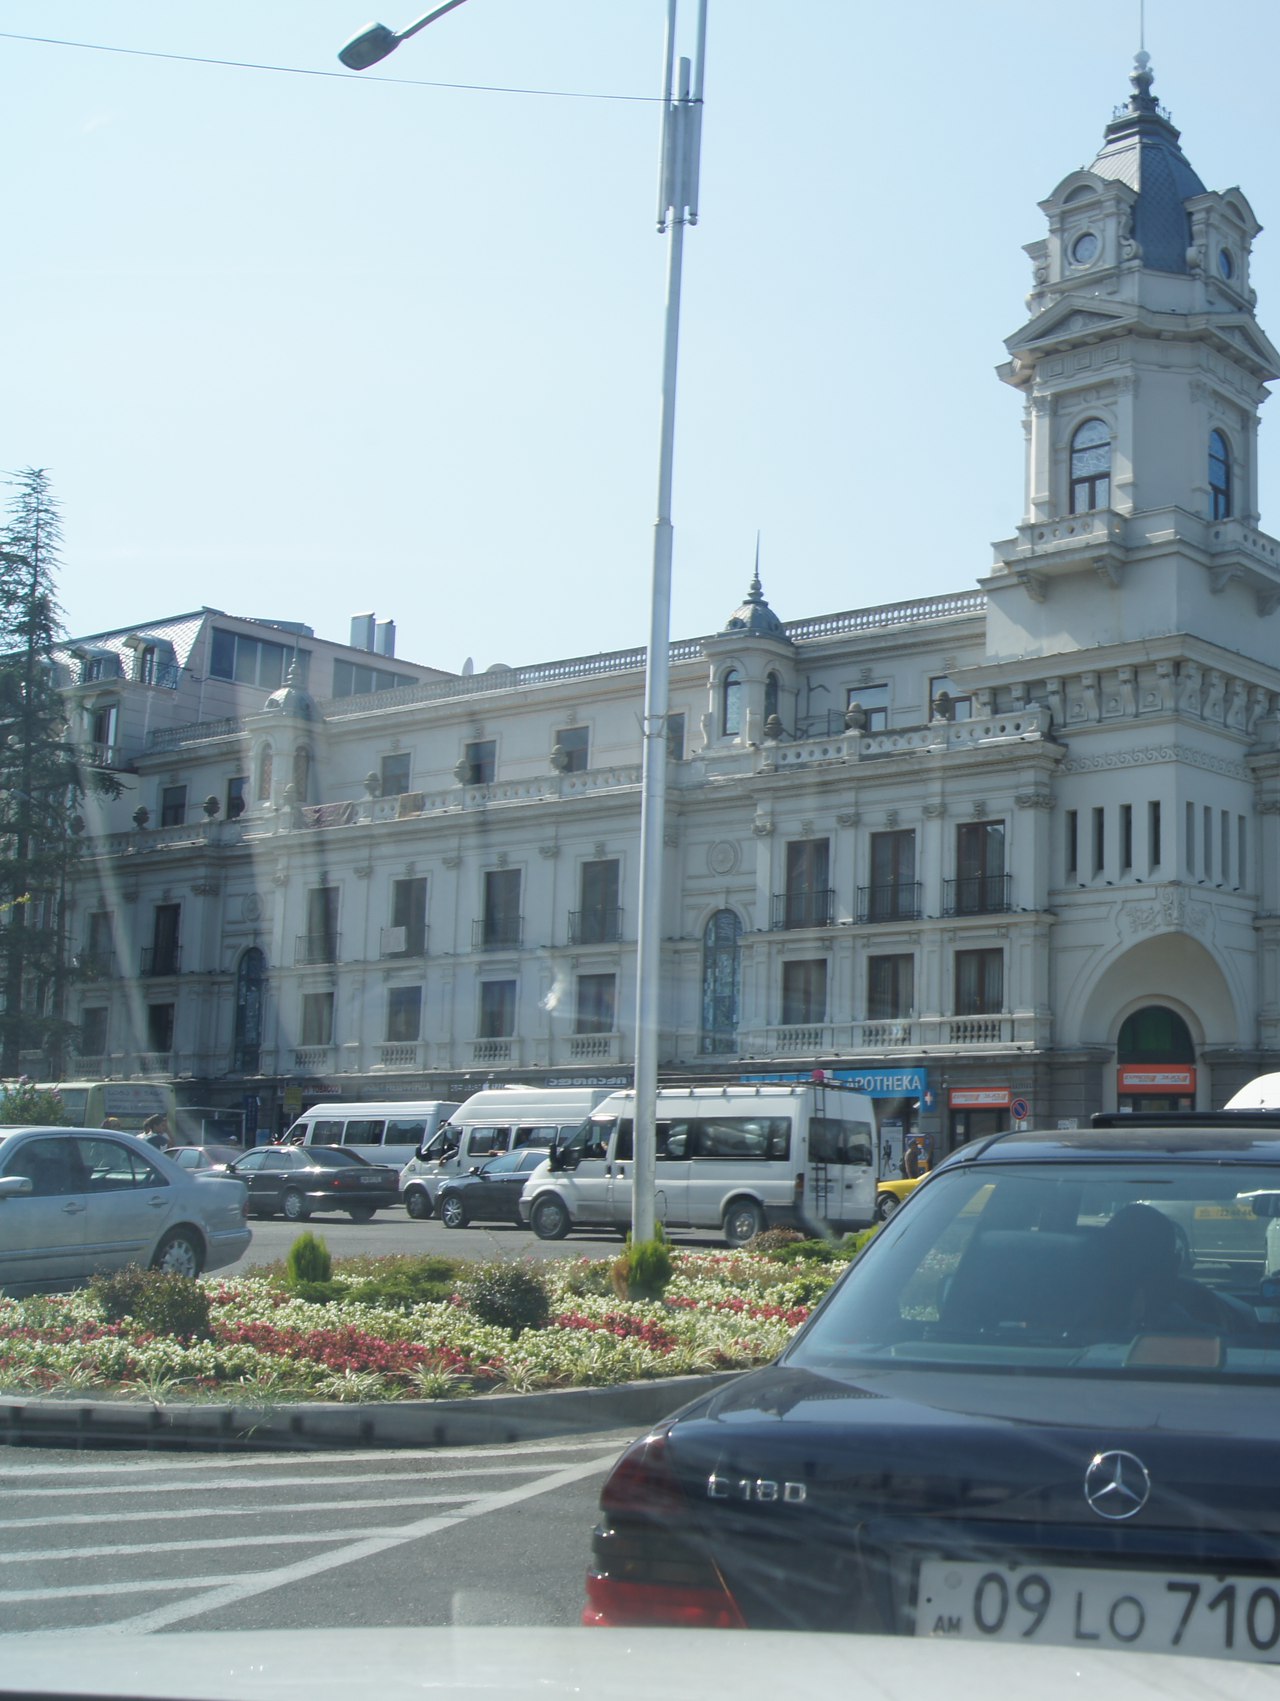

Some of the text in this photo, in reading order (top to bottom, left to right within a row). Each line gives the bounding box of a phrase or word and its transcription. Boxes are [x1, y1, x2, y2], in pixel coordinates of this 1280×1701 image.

[932, 1615, 962, 1635] AM
[973, 1572, 1051, 1638] 09
[1074, 1591, 1146, 1643] LO
